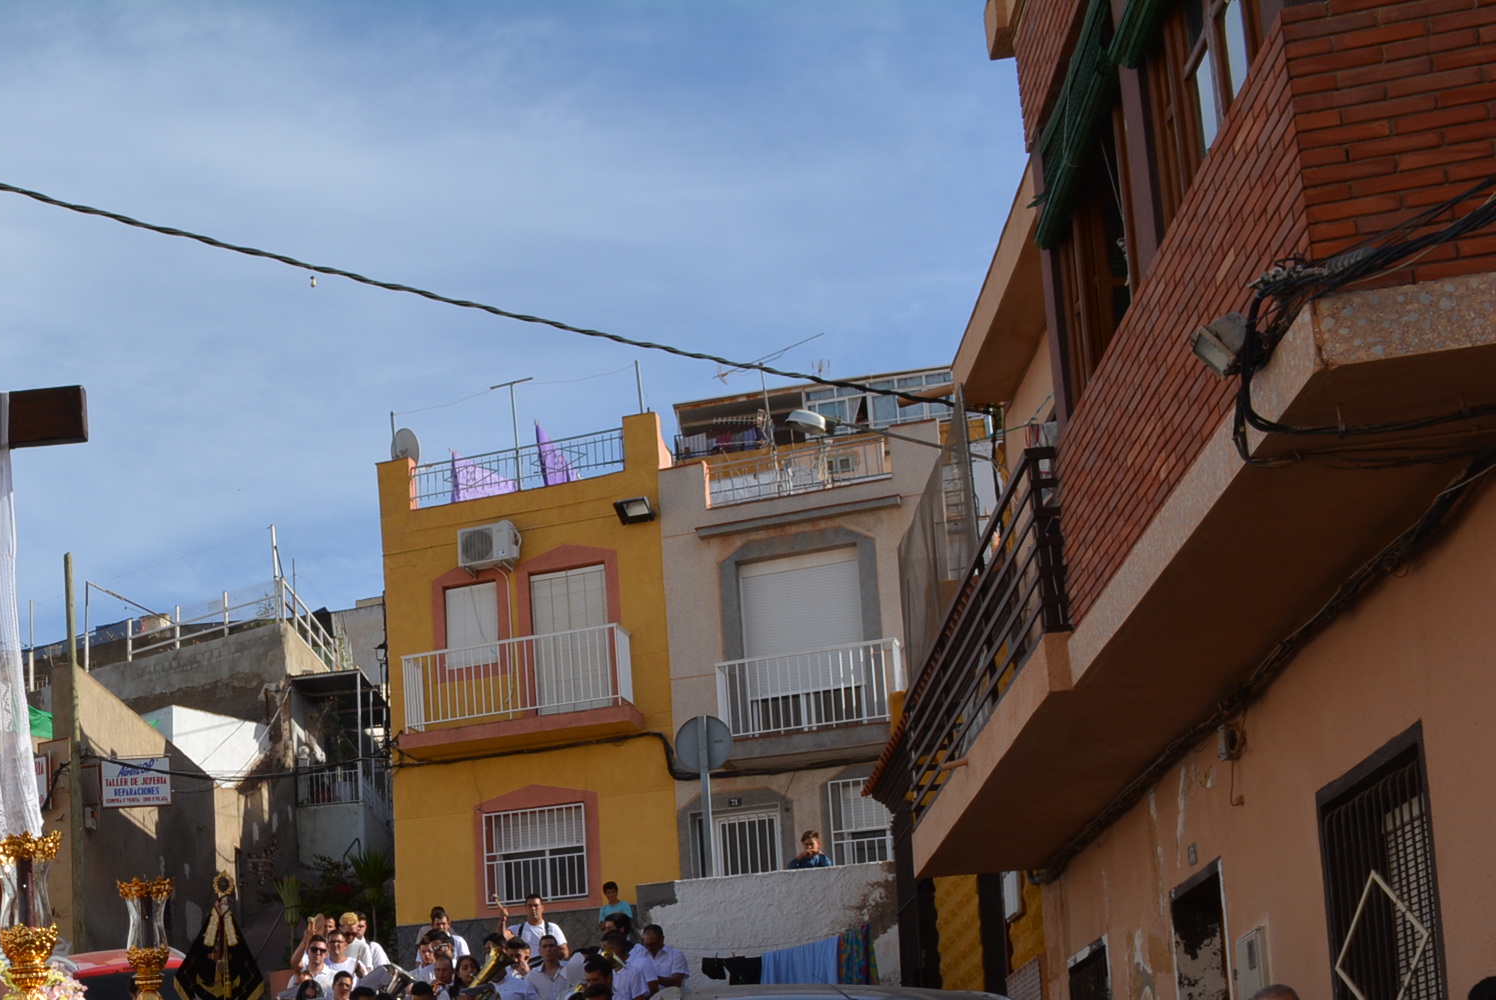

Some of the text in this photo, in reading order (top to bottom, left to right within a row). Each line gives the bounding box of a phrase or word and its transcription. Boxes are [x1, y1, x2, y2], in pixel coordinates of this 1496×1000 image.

[105, 777, 129, 787] TALLER
[131, 777, 139, 786] DE
[114, 786, 160, 797] REPARACIONES
